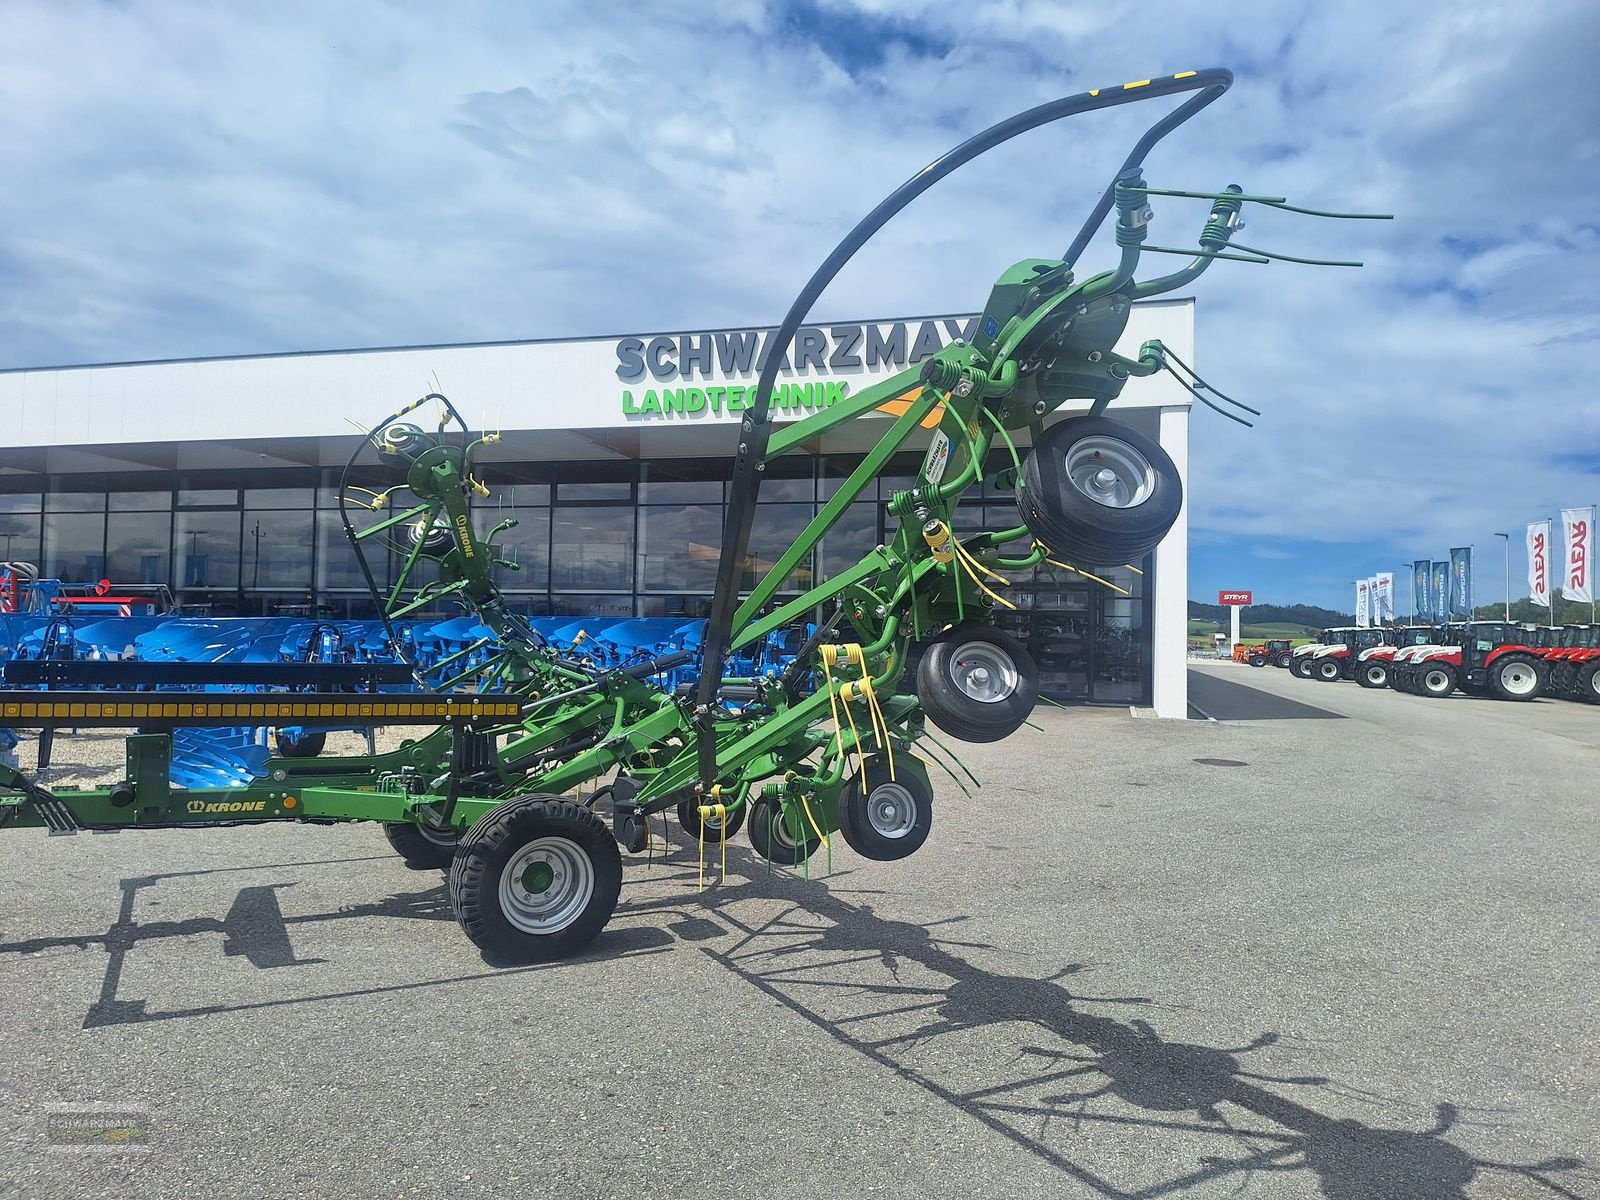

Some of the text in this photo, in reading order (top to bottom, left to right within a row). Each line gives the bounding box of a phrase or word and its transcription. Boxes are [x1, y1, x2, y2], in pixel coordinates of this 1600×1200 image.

[615, 317, 981, 377] SCHWARZMAY
[458, 526, 474, 559] KRONE
[205, 800, 267, 813] KRONE
